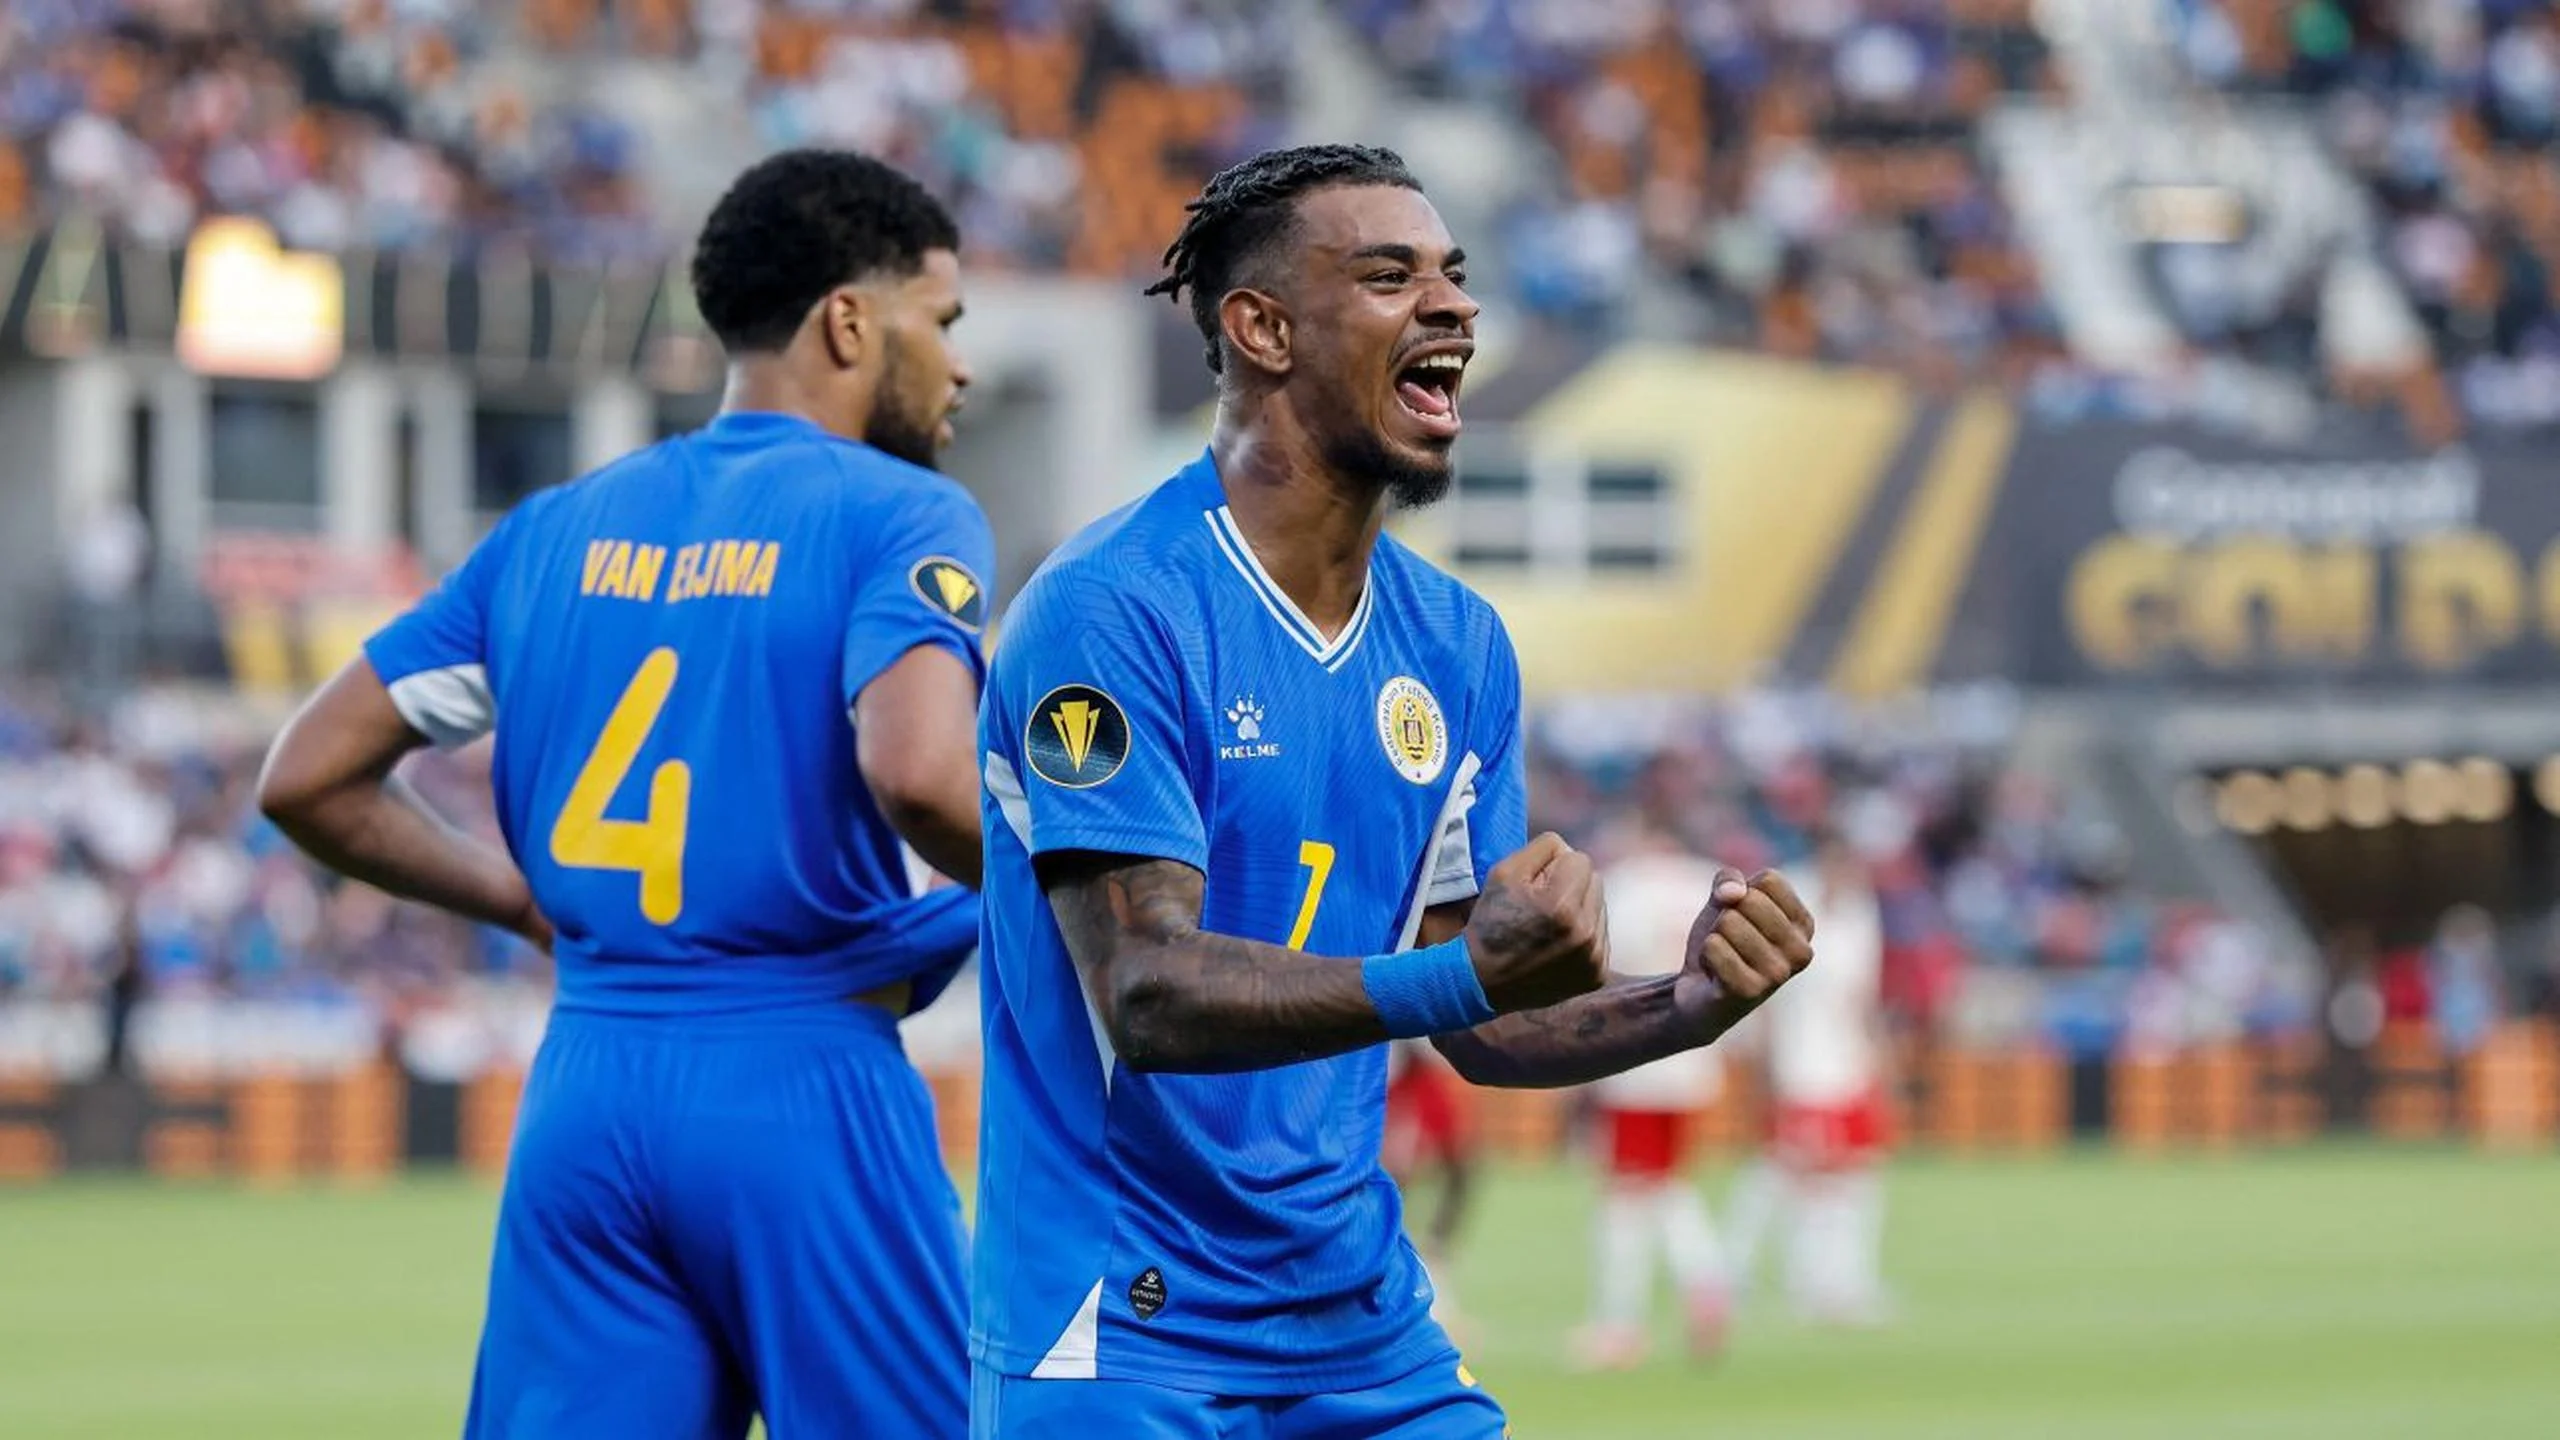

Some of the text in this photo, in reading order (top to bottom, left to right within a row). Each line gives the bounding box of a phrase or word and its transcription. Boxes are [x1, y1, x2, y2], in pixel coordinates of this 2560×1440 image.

[581, 538, 781, 604] VAN EIJMA
[550, 645, 691, 925] 4
[1221, 743, 1280, 760] KELME
[1288, 839, 1336, 951] 7
